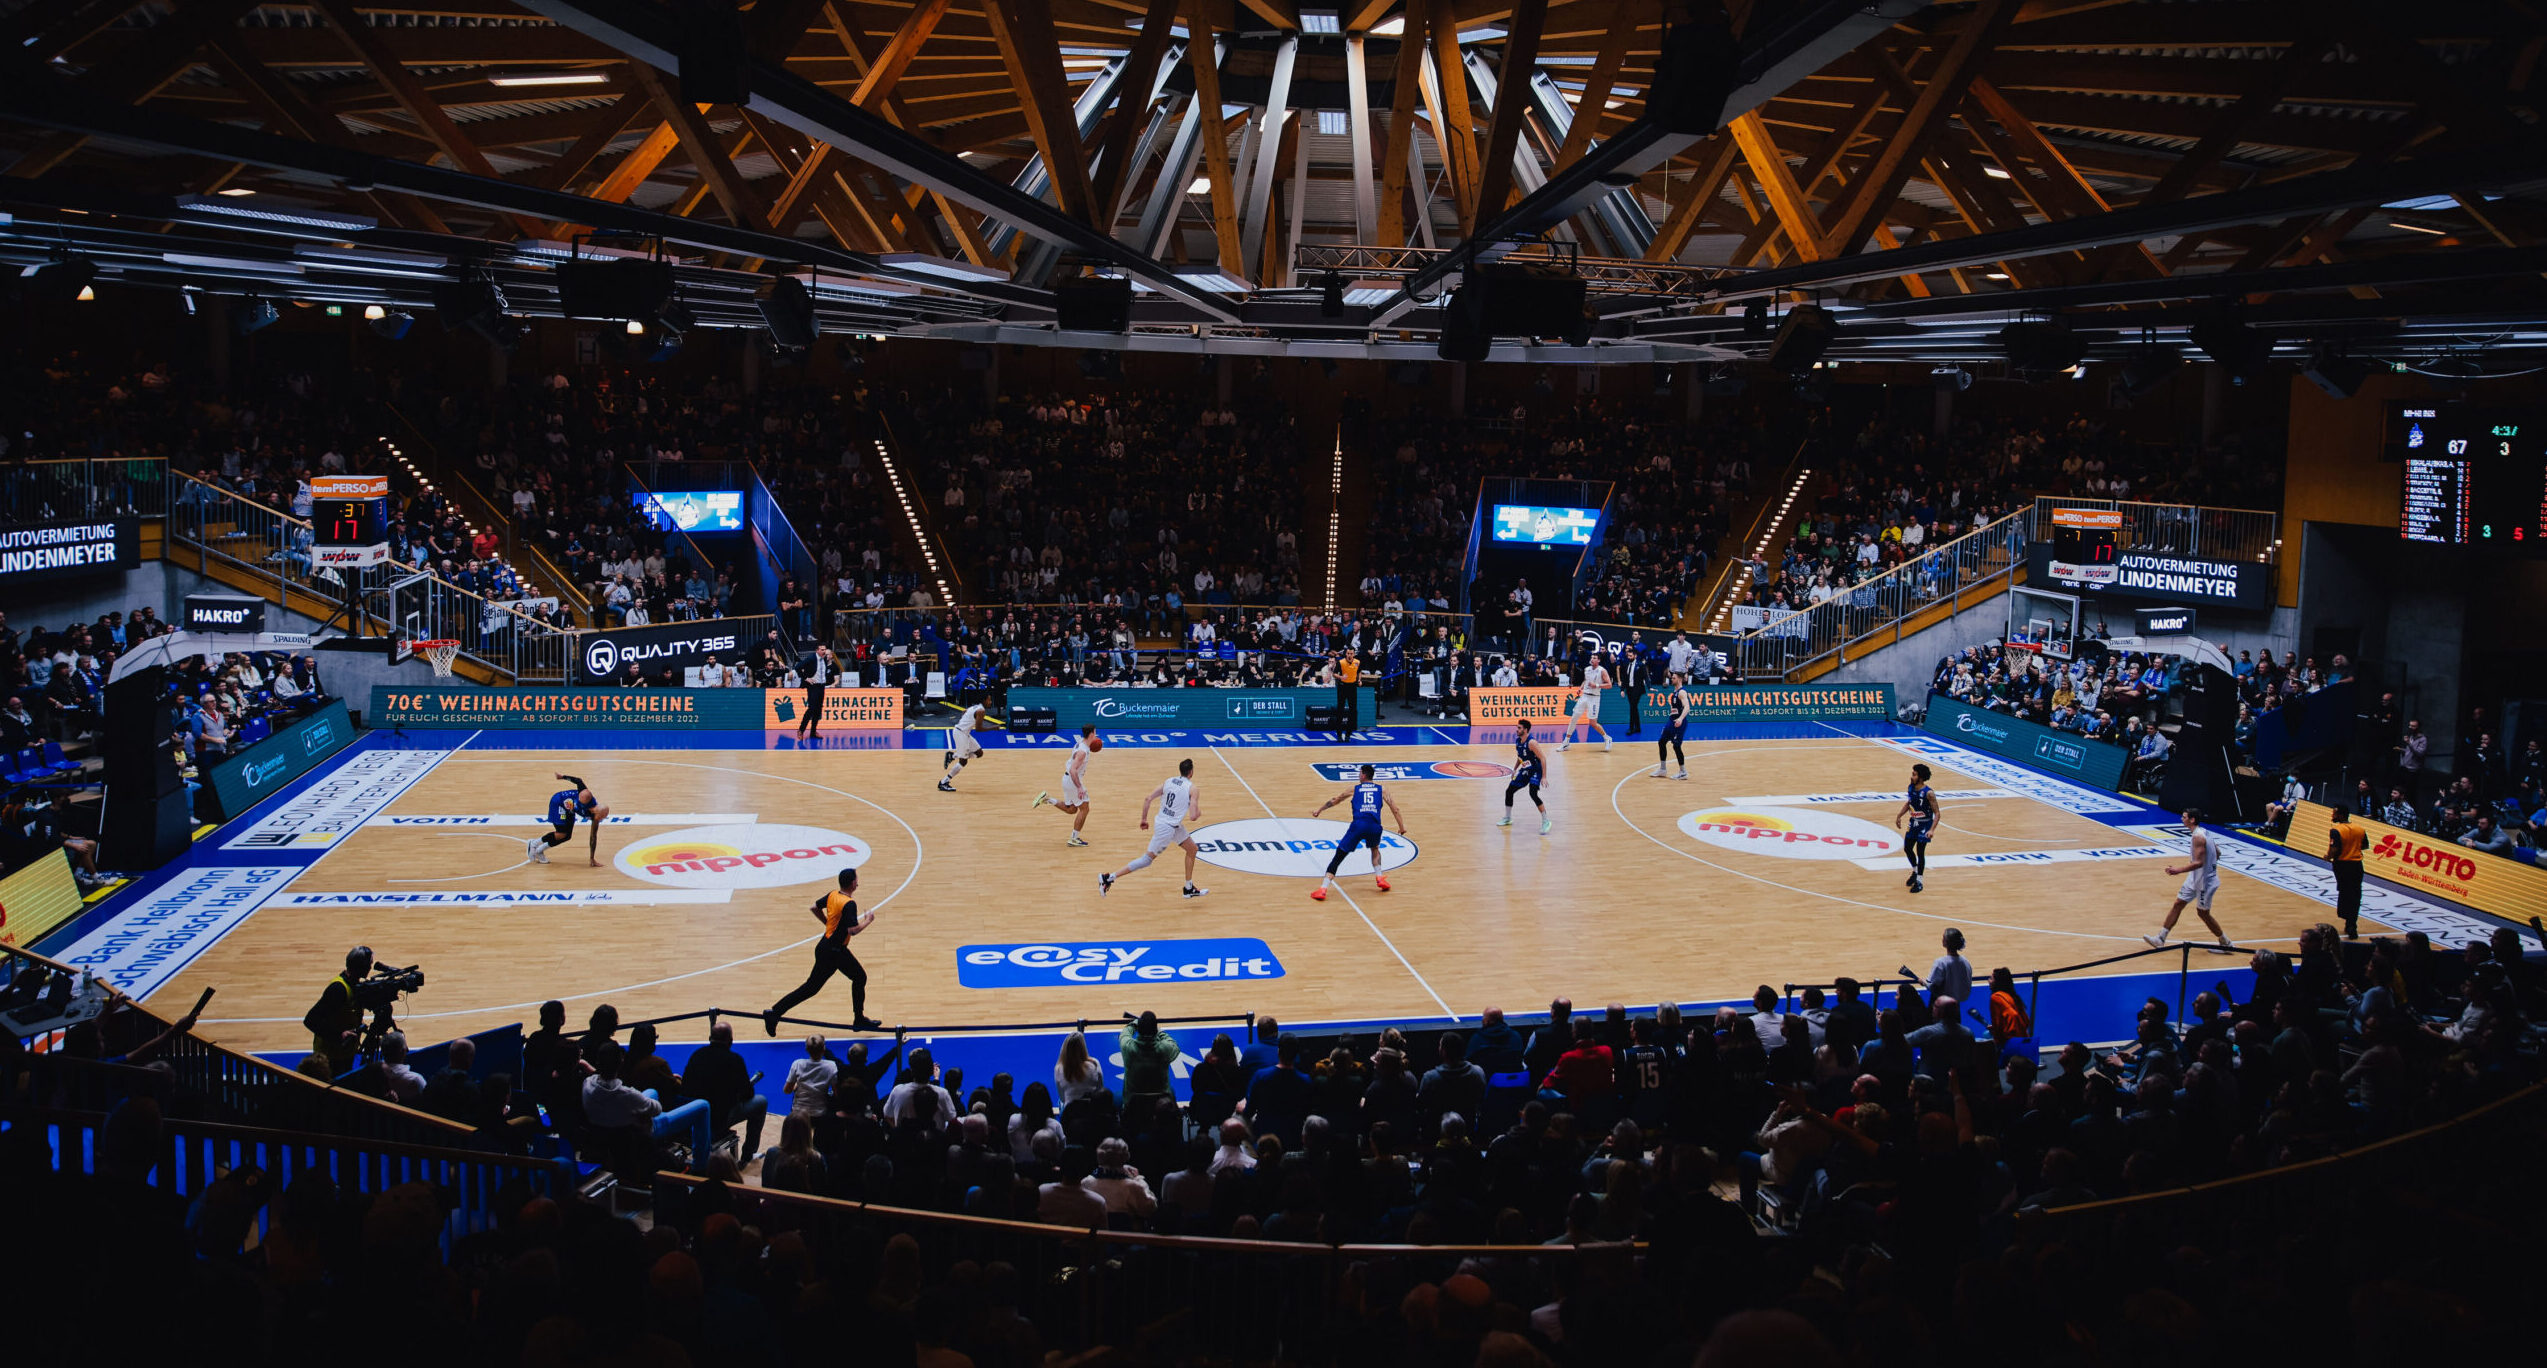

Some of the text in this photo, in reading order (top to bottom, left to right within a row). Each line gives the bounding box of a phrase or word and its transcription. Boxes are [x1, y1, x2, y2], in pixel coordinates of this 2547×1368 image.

[2448, 440, 2468, 454] 67
[2500, 442, 2510, 455] 3
[334, 520, 357, 540] 17
[2482, 525, 2492, 538] 3
[2513, 527, 2524, 540] 5
[2095, 544, 2112, 560] 17
[2119, 555, 2238, 578] AUTOVERMIETUNG
[2119, 570, 2237, 597] LINDENMEYER
[273, 635, 312, 644] SPALDING
[701, 635, 735, 652] 365
[440, 694, 694, 712] WEIHNACHTSGUTSCHEINE
[1253, 701, 1288, 710] DER STALL
[1479, 694, 1558, 706] WEIHNACHTS
[1688, 690, 1884, 707] WEIHNACHTSGUTSCHEINE
[1118, 701, 1181, 713] Buckenmaier
[1482, 706, 1557, 718] GUTSCHEINE
[1688, 708, 1737, 717] GESCHENKT
[1749, 708, 1761, 716] AB
[1763, 707, 1794, 716] SOFORT
[1797, 707, 1809, 715] BIS
[1824, 706, 1866, 715] DEZEMBER
[1868, 706, 1885, 714] 2022
[409, 713, 439, 722] EUCH
[442, 713, 504, 723] GESCHENKT
[522, 714, 536, 723] AB
[539, 714, 579, 723] SOFORT
[583, 714, 599, 723] BIS
[619, 714, 674, 723] DEZEMBER
[676, 714, 700, 723] 2022
[1202, 731, 1396, 743] MERLINS
[344, 751, 400, 776] WEISS
[311, 751, 438, 833] BAUUNTERNEHMUNG
[1363, 791, 1374, 804] 15
[259, 779, 359, 833] LEONHARD
[392, 817, 490, 825] VOITH
[1698, 820, 1891, 849] nippon
[646, 844, 858, 875] nippon
[1963, 852, 2052, 863] VOITH
[2081, 847, 2165, 857] VOITH
[2402, 841, 2477, 881] LOTTO
[2397, 866, 2469, 898] Baden-Württemberg
[214, 884, 259, 912] Hall
[246, 869, 282, 883] eG
[292, 893, 575, 903] HANSELMANN
[70, 869, 234, 964] Bank Heilbronn
[1060, 957, 1272, 981] Credit
[1636, 1061, 1660, 1089] 15
